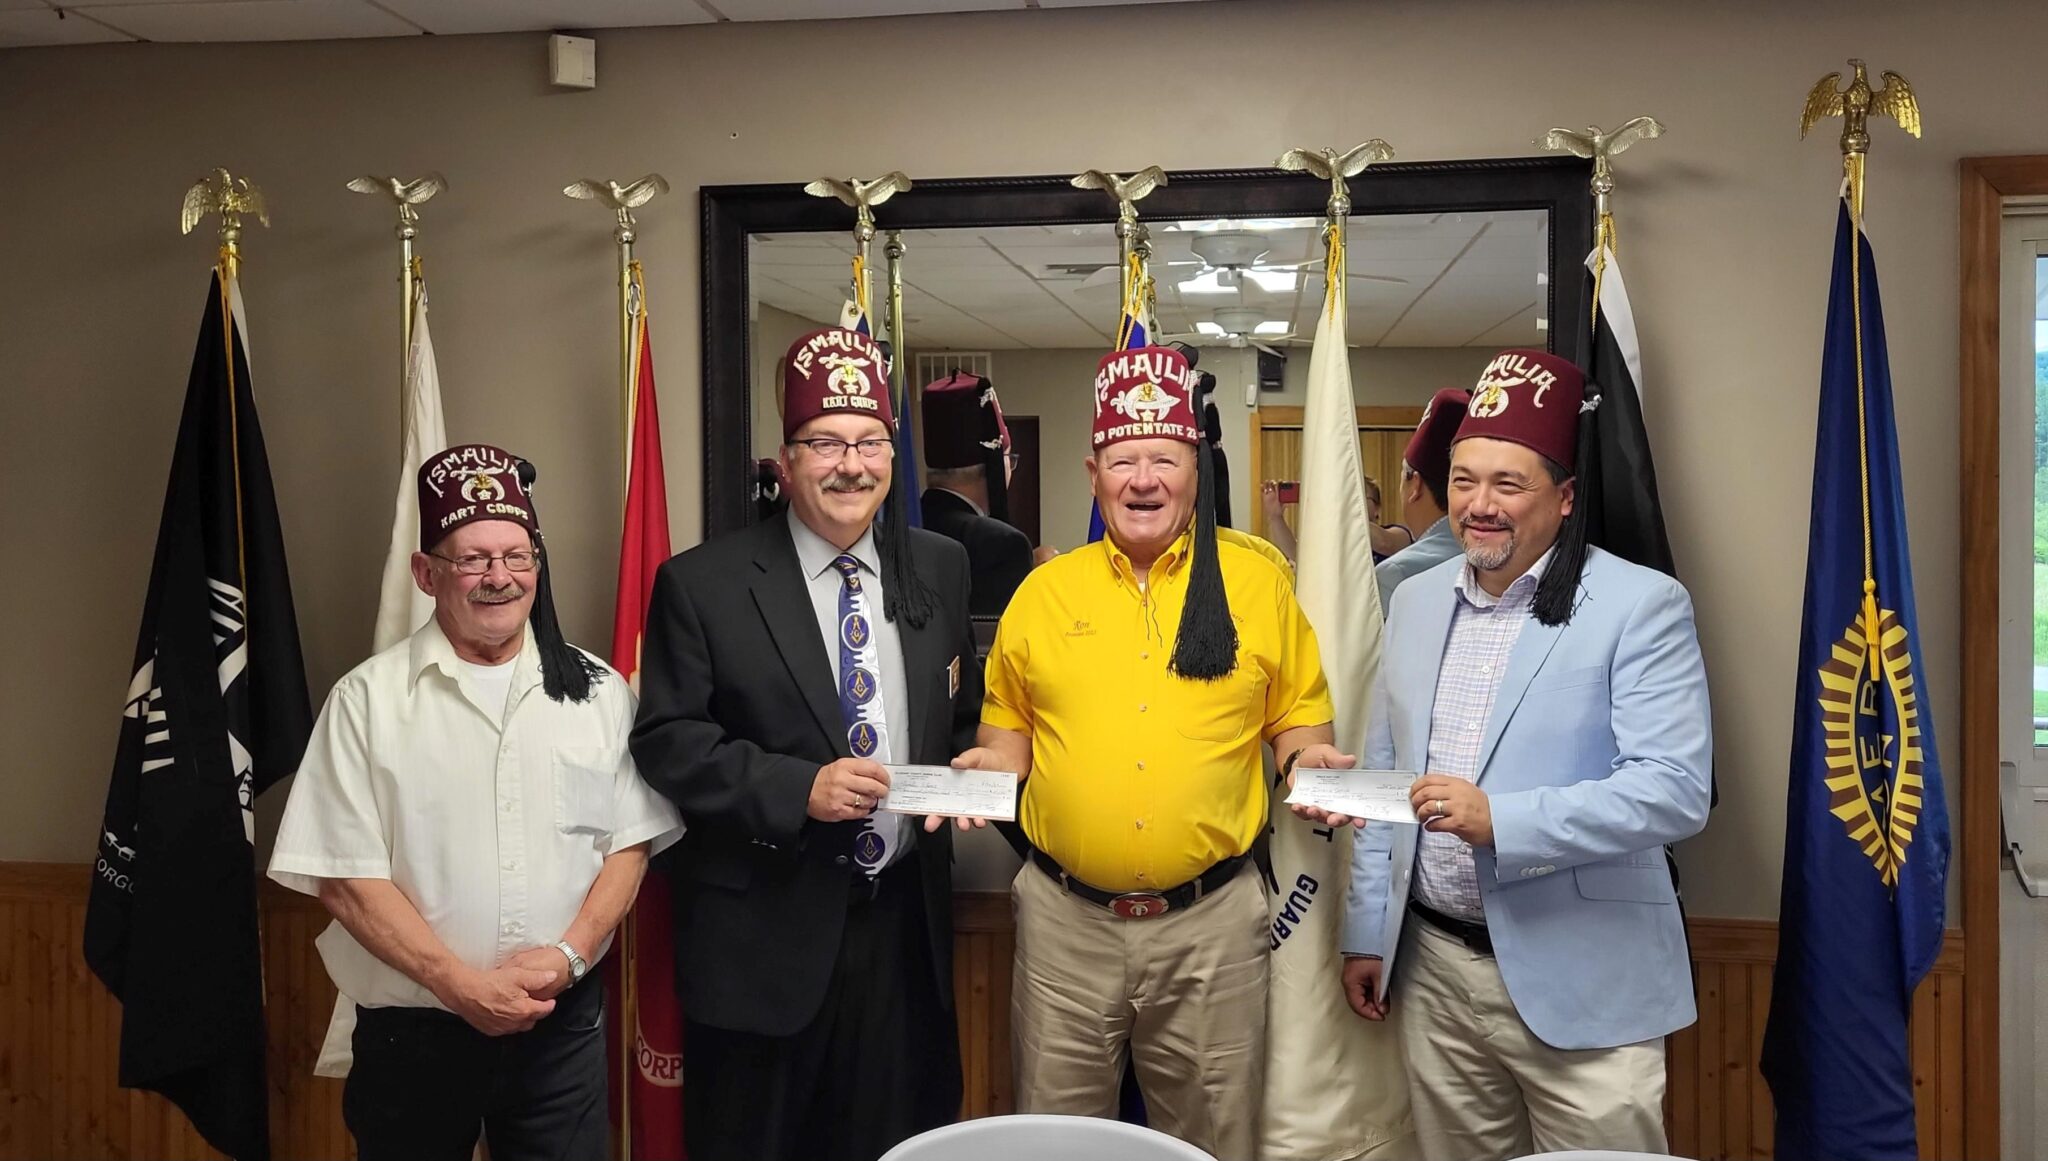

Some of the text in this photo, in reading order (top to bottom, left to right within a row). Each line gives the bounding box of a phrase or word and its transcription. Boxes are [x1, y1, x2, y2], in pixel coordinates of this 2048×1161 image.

[793, 330, 885, 384] ISMAILIA
[1094, 431, 1105, 444] 20
[1108, 422, 1184, 439] POTENTATE
[426, 447, 524, 498] ISMAILIA
[441, 503, 528, 528] KART CORPS
